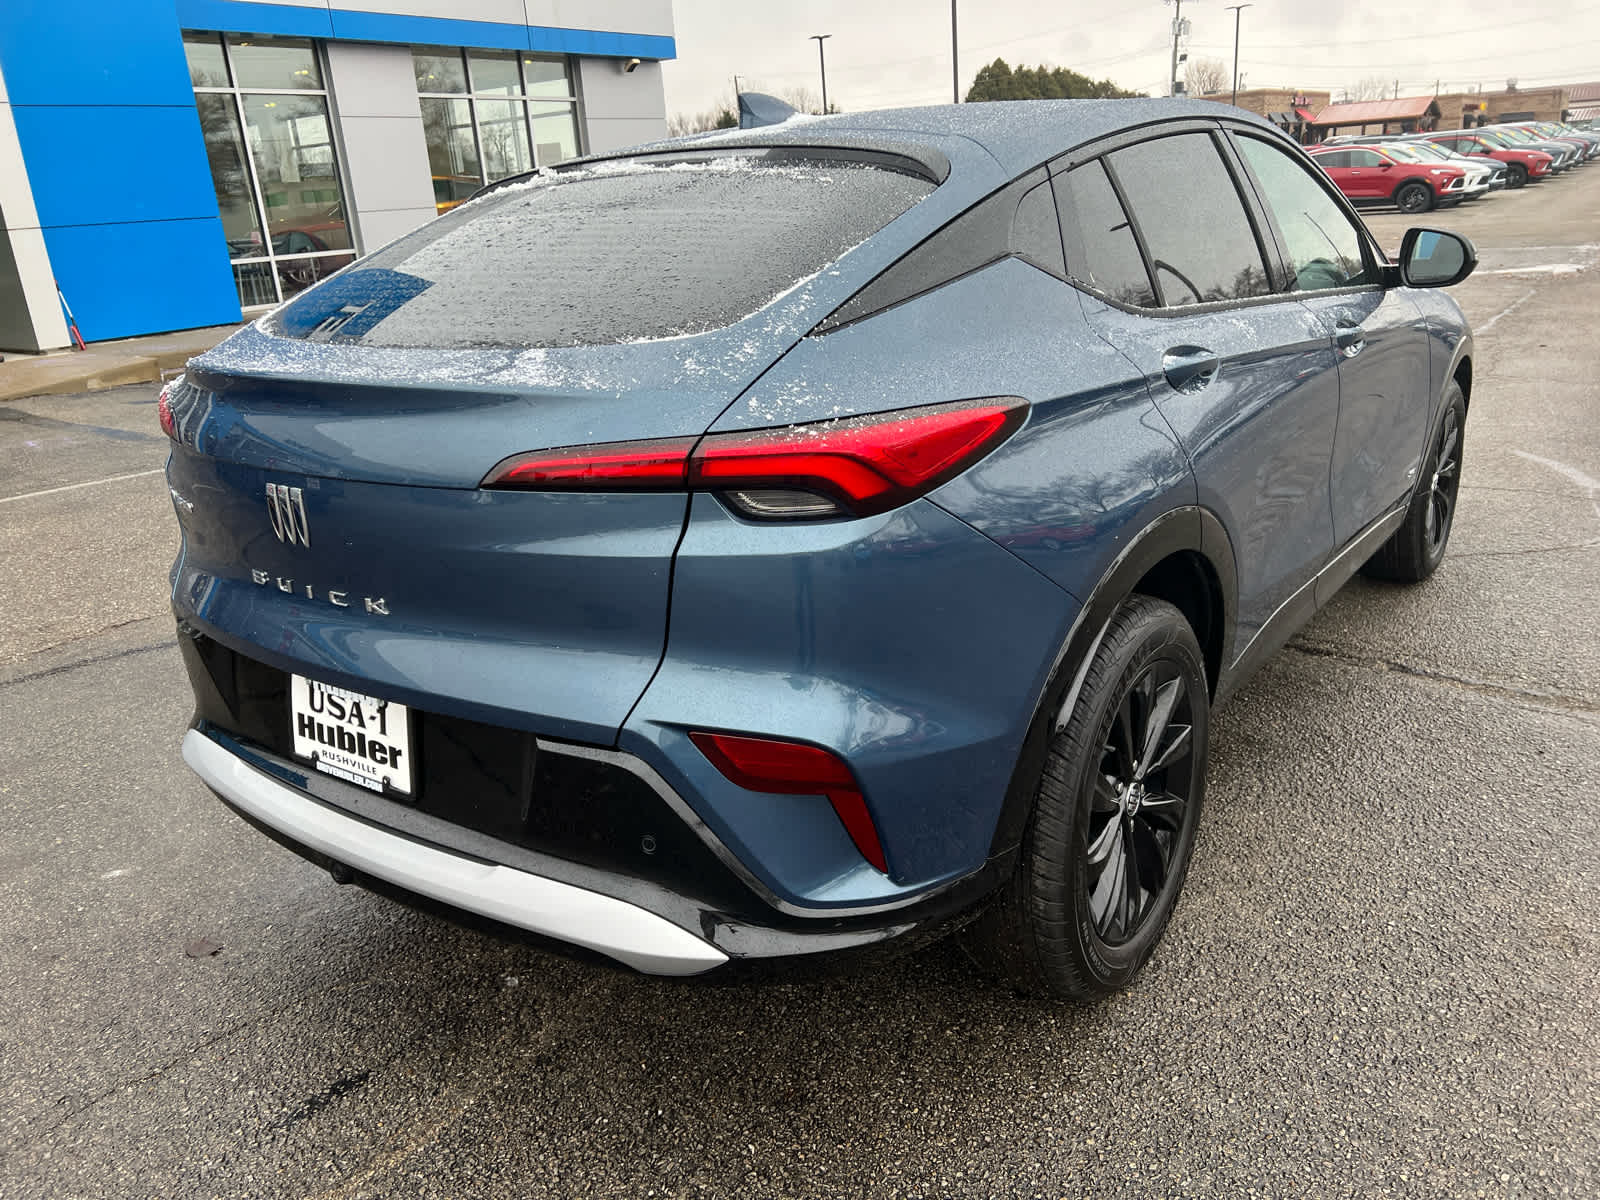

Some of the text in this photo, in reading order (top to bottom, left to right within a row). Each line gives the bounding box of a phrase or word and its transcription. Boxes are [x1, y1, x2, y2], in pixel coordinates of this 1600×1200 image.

[252, 568, 390, 615] BUICK
[309, 682, 388, 736] USA-1
[297, 712, 402, 769] Hubler
[322, 750, 377, 776] RUSHVILLE
